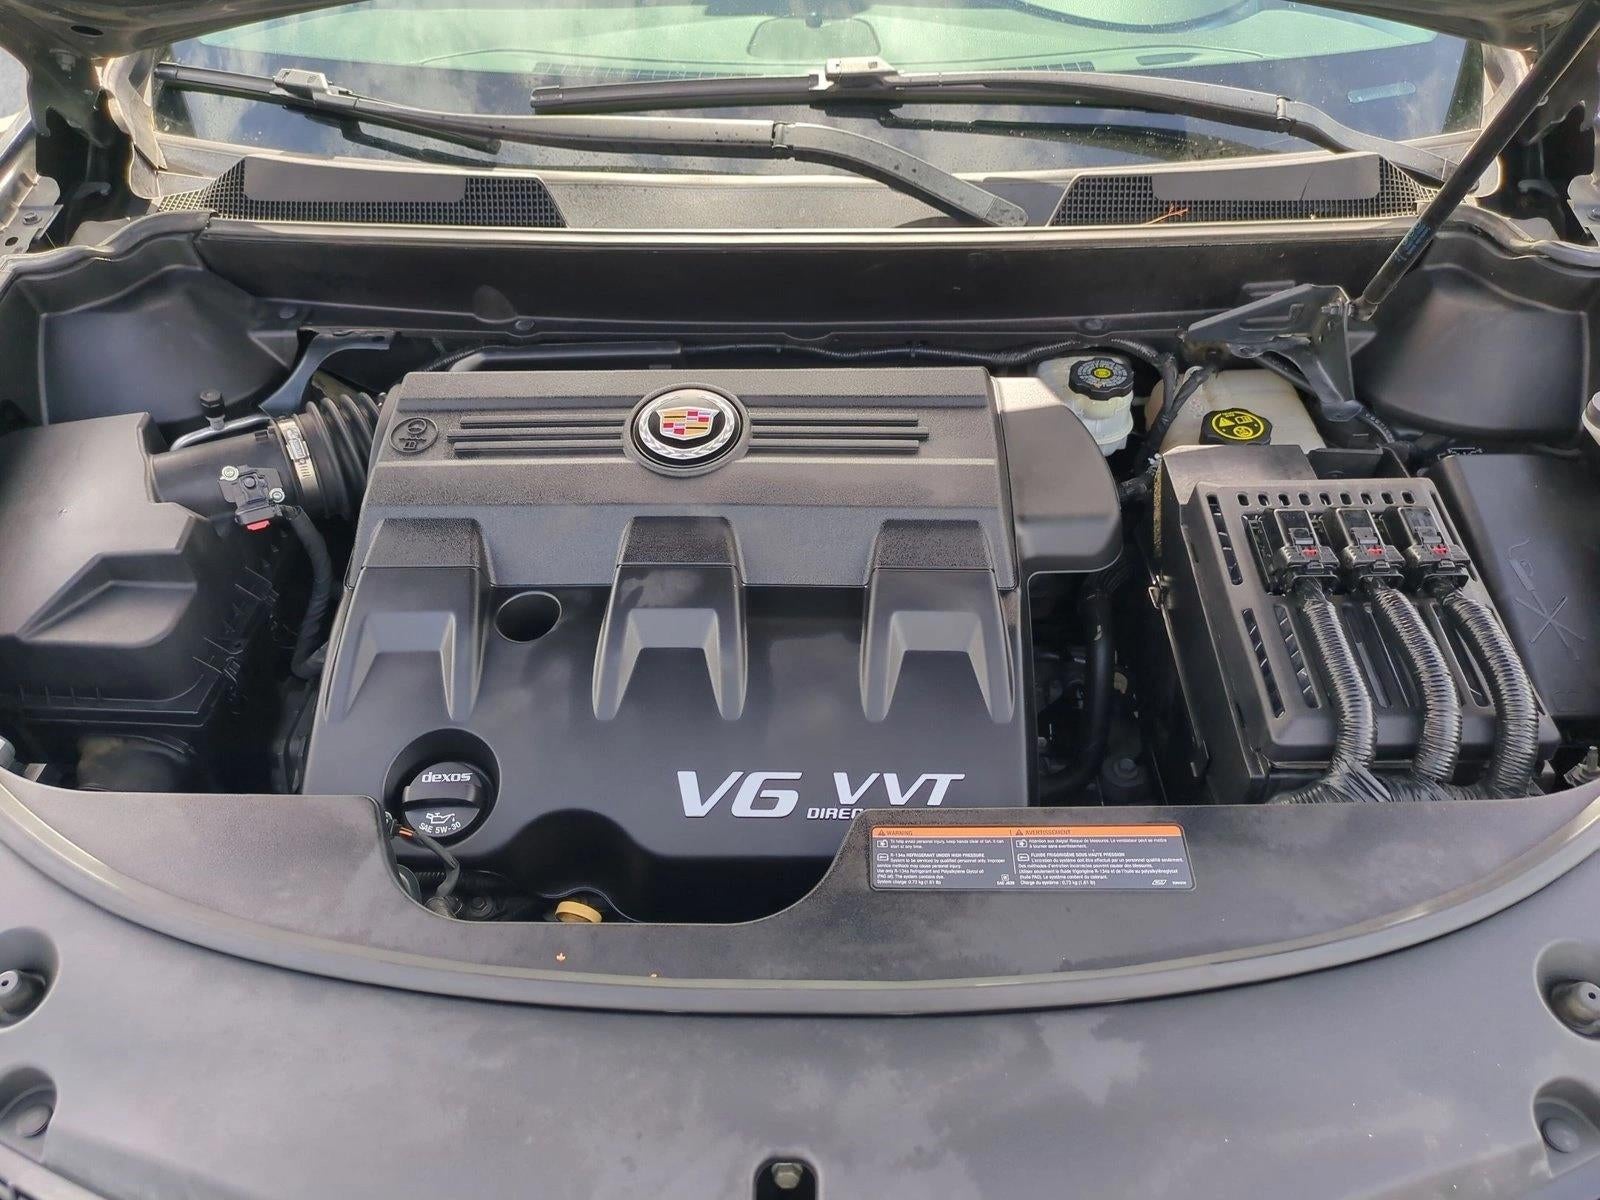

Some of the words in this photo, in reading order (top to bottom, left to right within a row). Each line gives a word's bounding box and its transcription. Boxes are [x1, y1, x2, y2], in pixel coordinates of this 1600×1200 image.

[422, 771, 473, 783] dexos
[676, 770, 803, 818] V6
[833, 772, 966, 806] VVT
[418, 822, 433, 834] SAE
[434, 821, 461, 834] 5W-30
